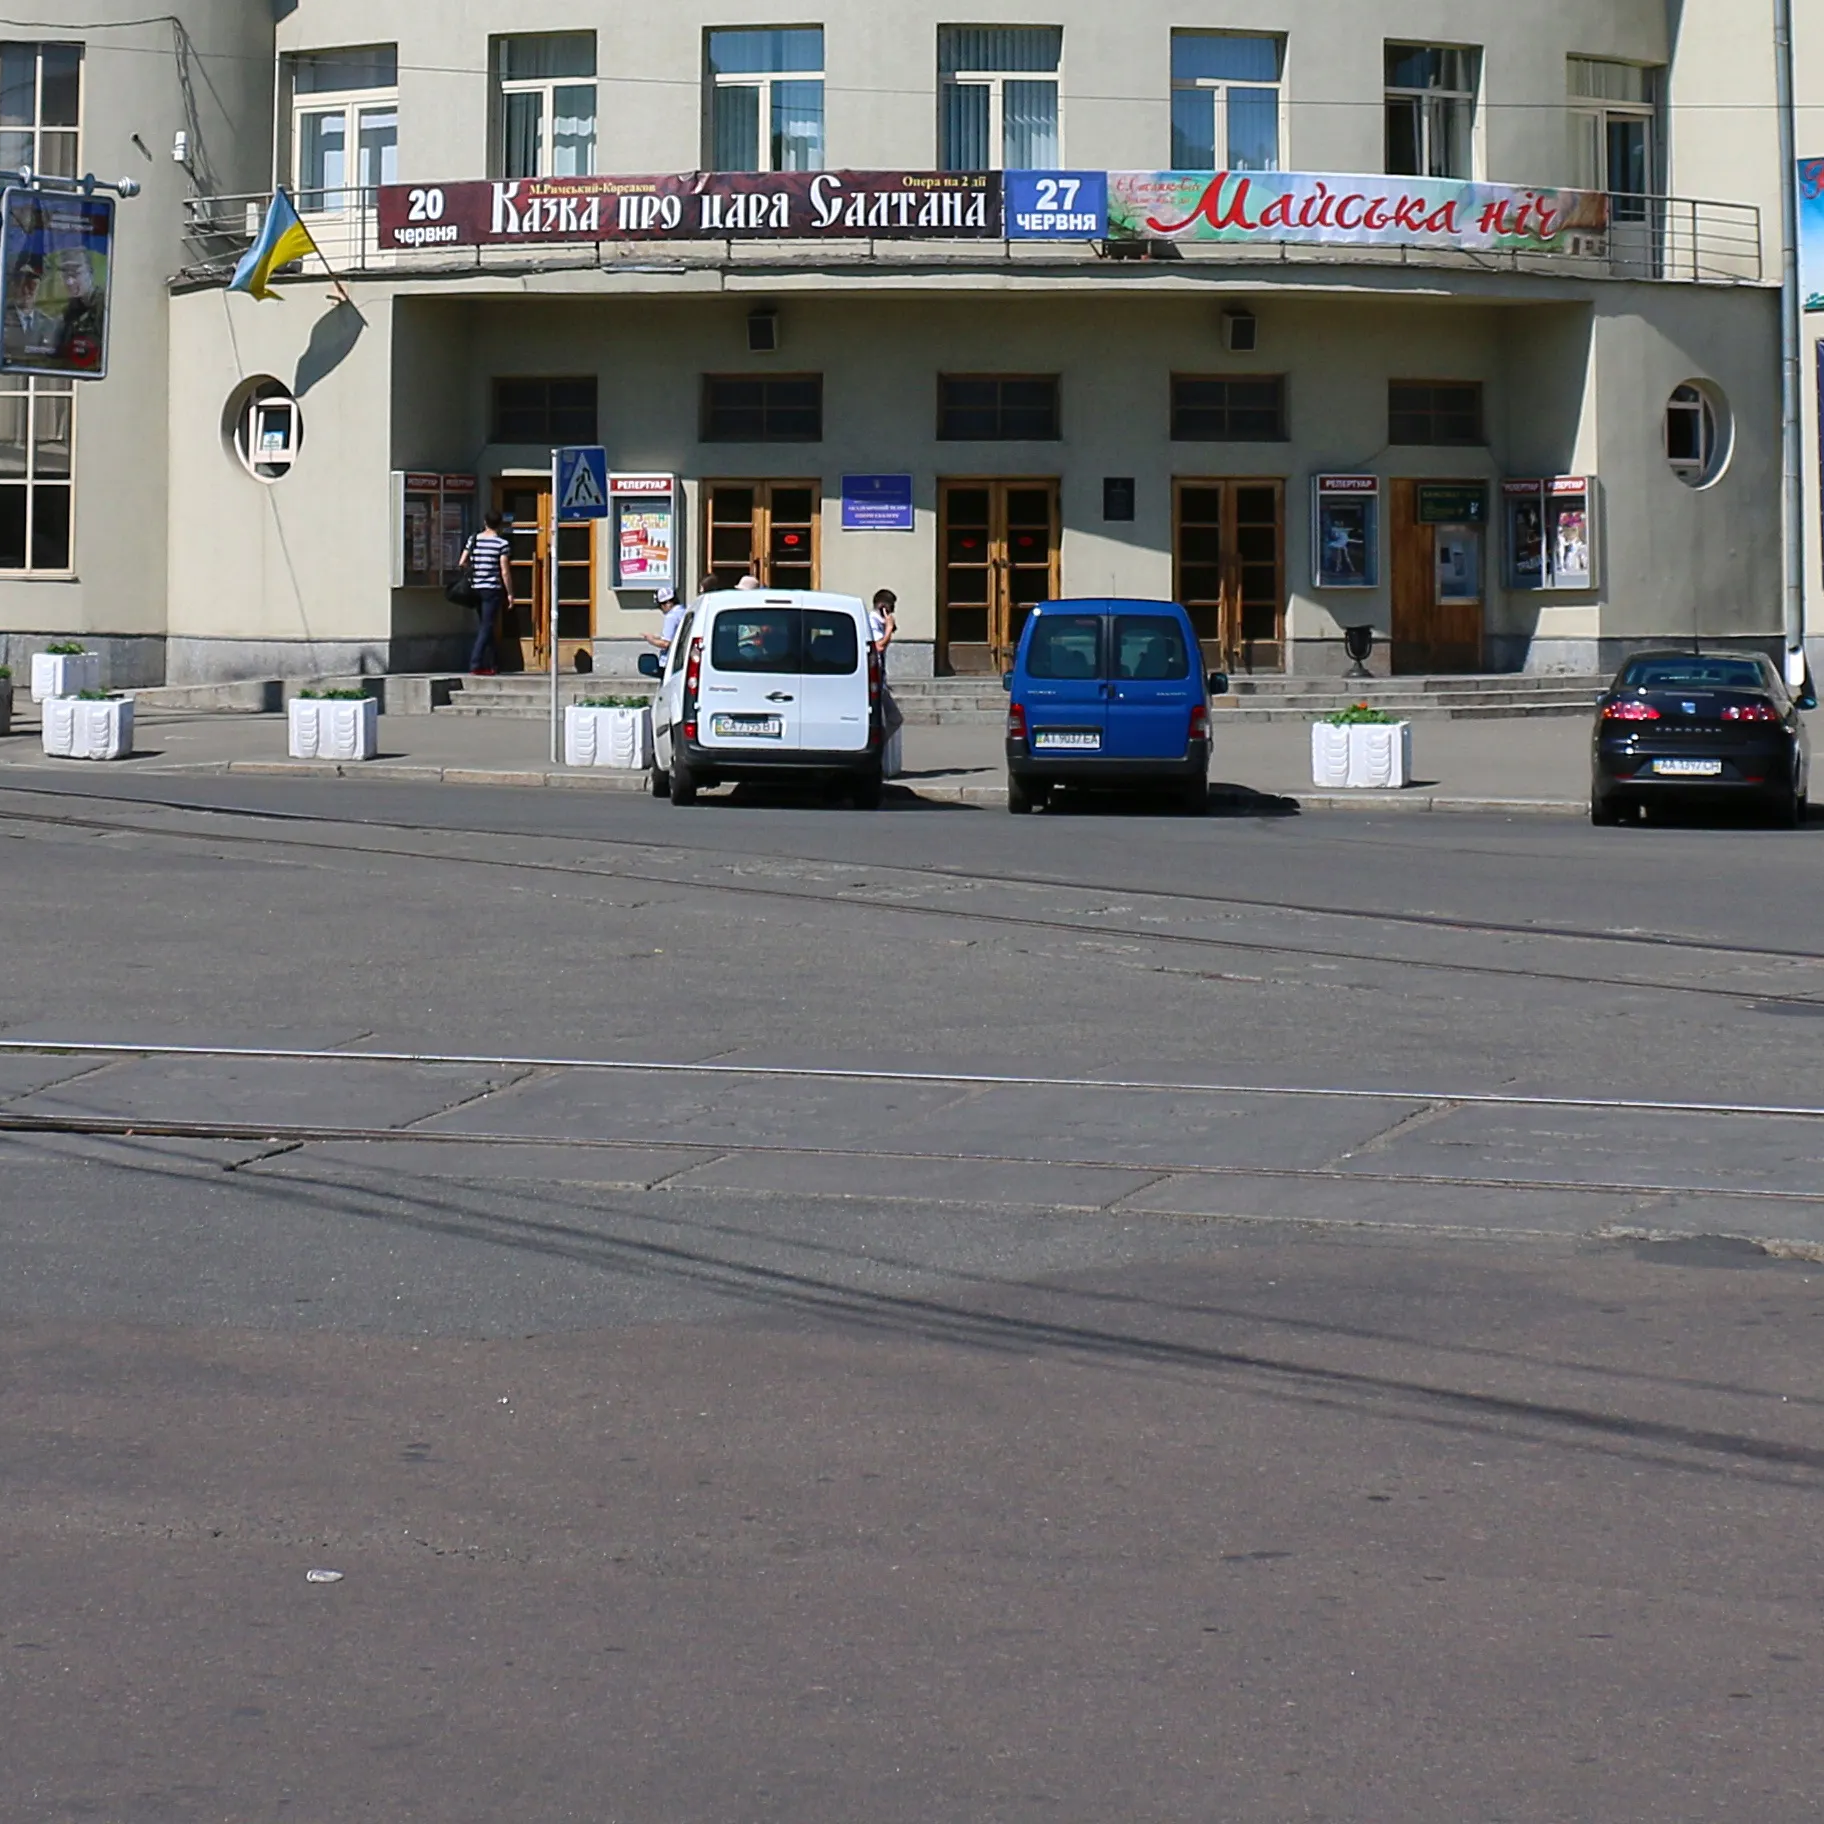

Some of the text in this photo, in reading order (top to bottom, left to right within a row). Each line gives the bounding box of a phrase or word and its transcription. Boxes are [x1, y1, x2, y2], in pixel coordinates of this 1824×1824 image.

[903, 176, 940, 190] Опера
[943, 178, 958, 187] на
[960, 176, 968, 187] 2
[408, 189, 444, 221] 20
[1035, 179, 1081, 212] 27
[1147, 171, 1562, 242] Майська ніч
[1015, 214, 1097, 232] ЧЕРВНЯ
[394, 224, 458, 247] червня
[617, 479, 668, 491] РЕПЕРТУАР
[1326, 479, 1372, 488] РЕПЕРТУАР
